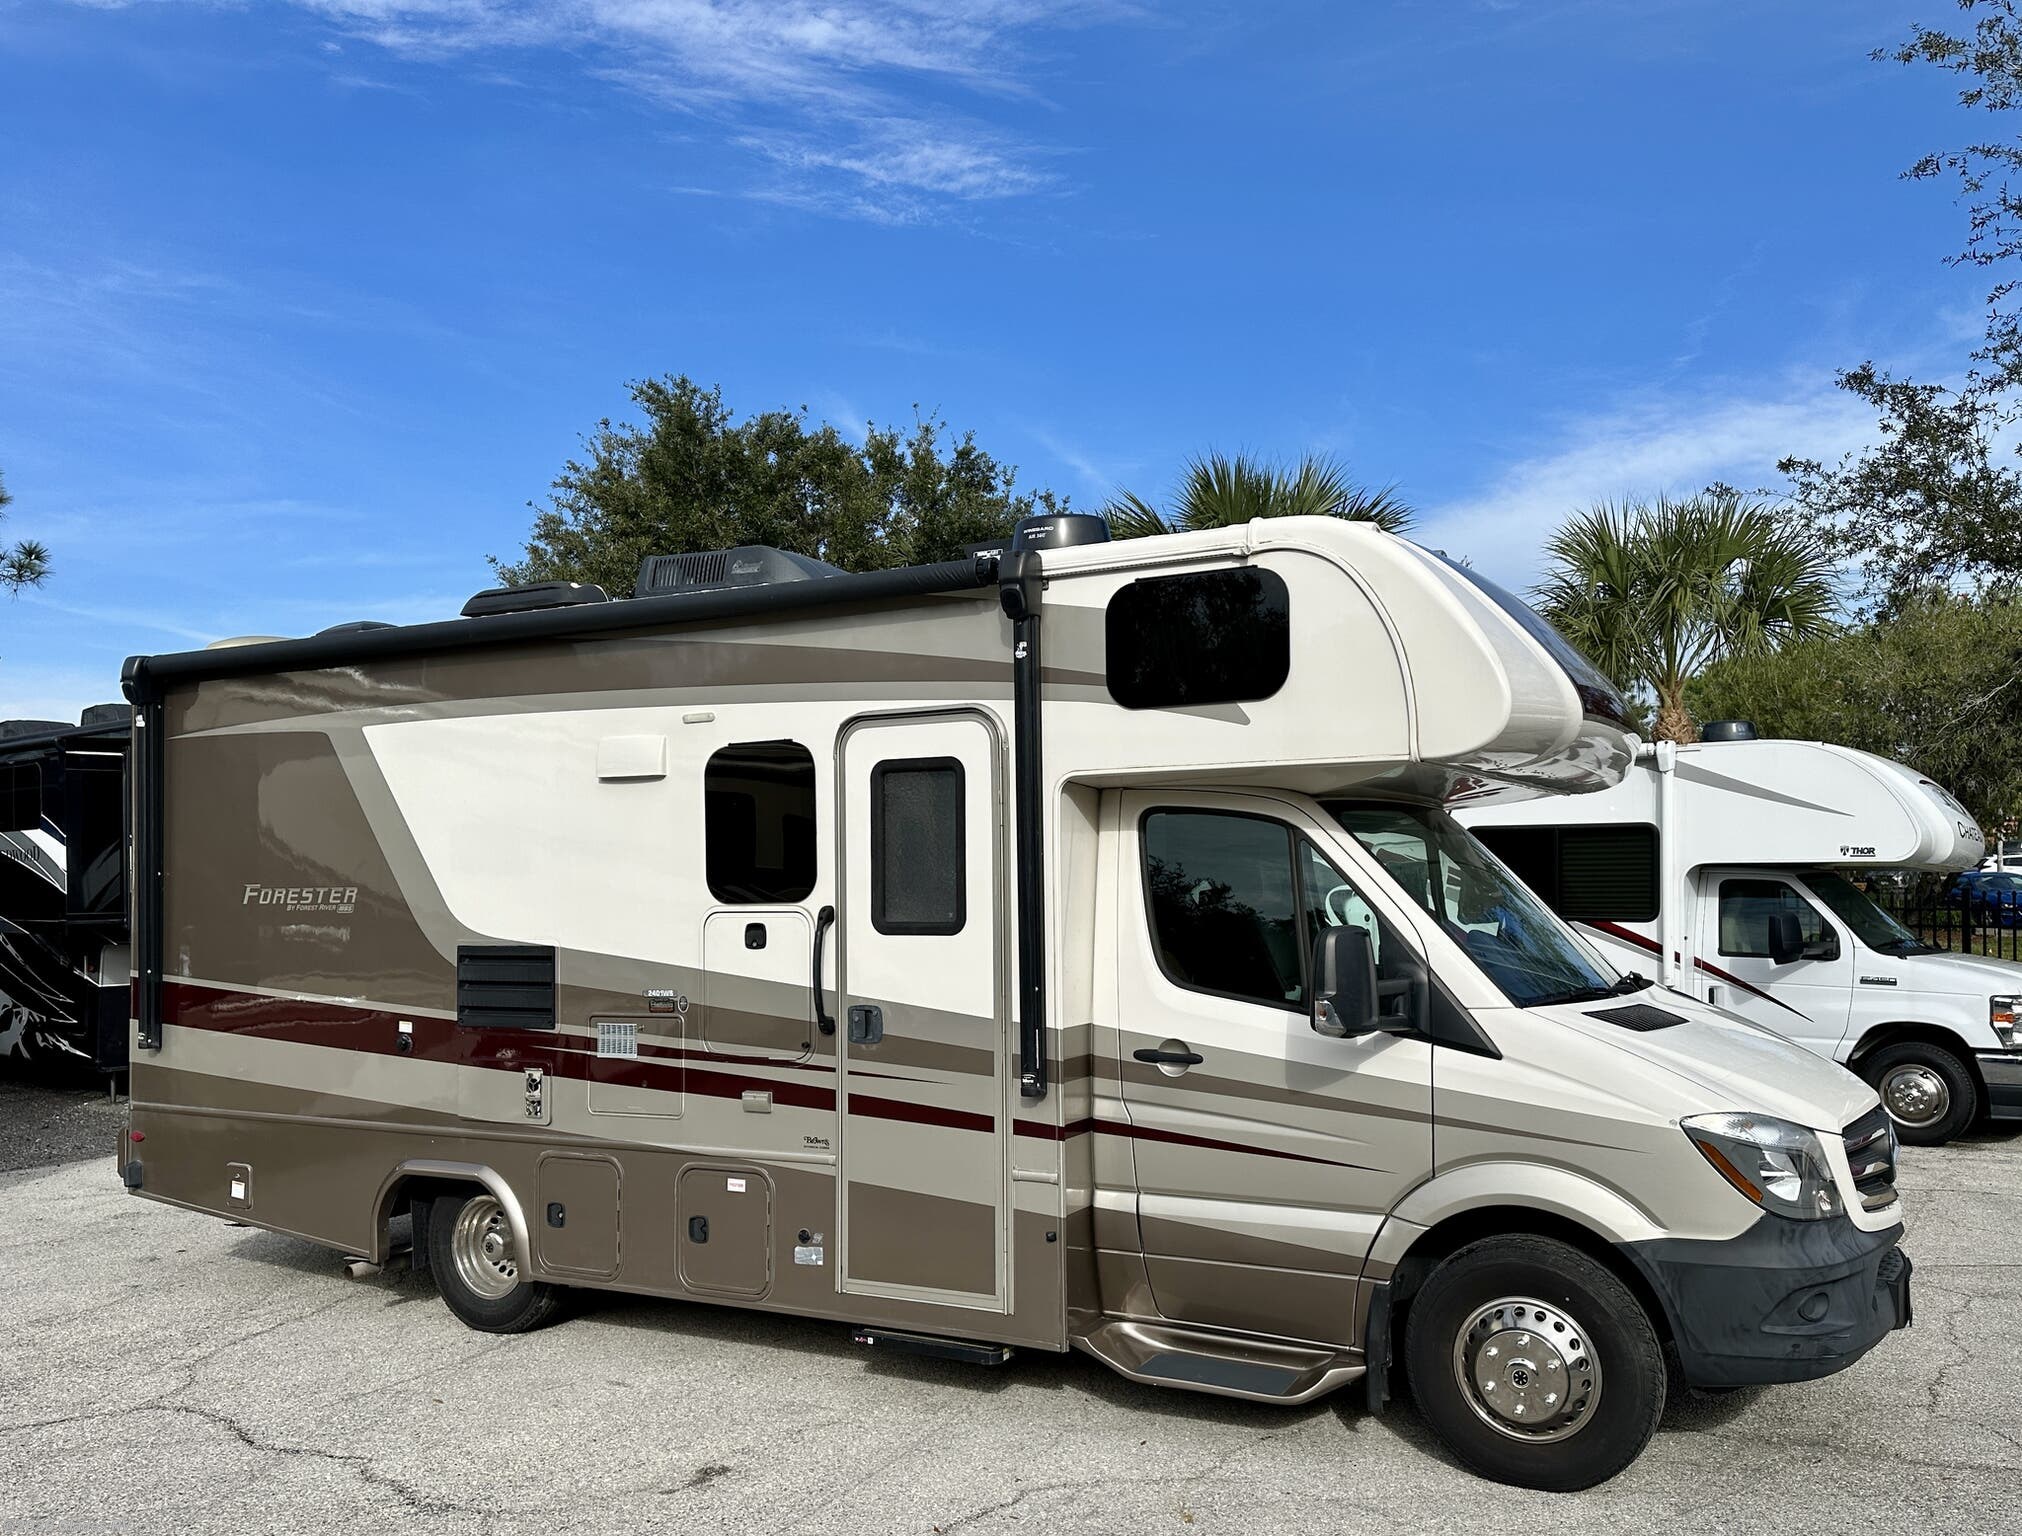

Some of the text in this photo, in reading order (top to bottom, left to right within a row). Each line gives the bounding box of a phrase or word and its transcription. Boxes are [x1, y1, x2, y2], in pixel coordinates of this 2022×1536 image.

[1850, 847, 1876, 855] THOR
[243, 883, 359, 905] FORESTER
[286, 904, 297, 912] BY
